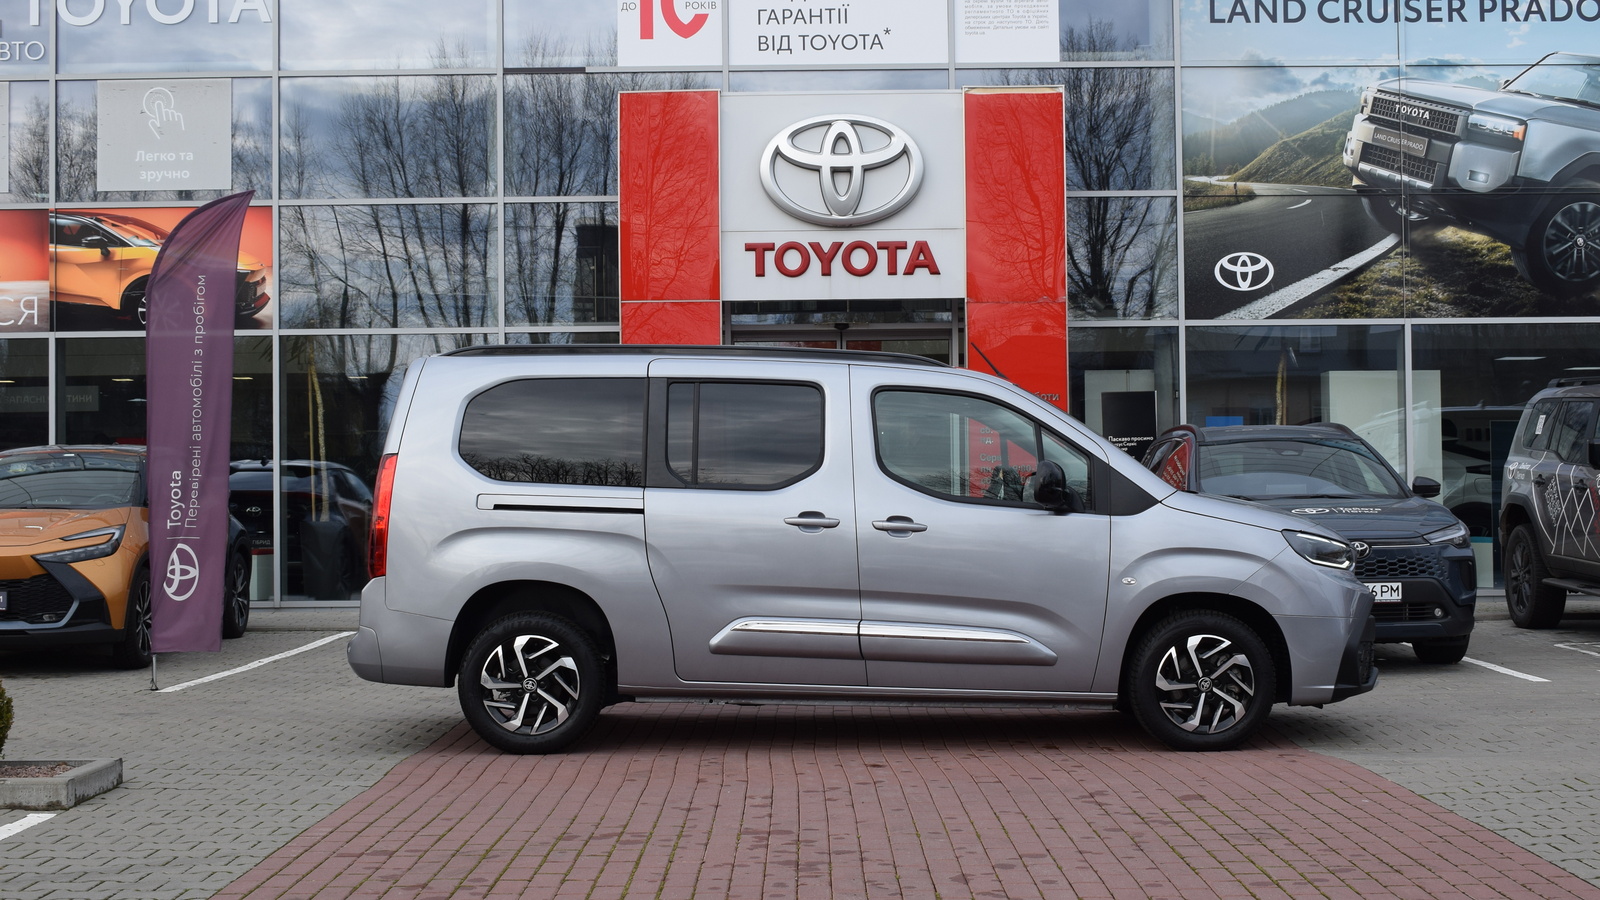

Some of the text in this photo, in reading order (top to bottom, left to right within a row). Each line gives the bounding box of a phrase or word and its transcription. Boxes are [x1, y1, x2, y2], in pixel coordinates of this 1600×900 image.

[620, 2, 637, 12] ДО
[685, 1, 717, 10] РОКІВ
[757, 4, 849, 26] ГАРАНТІЇ
[1209, 0, 1600, 24] LAND CRUISER PRADO
[758, 35, 793, 55] ВІД
[1395, 104, 1430, 120] TOYOTA
[1374, 132, 1424, 151] LAND CRUISER PRADO
[135, 150, 194, 163] Легко та
[139, 168, 190, 183] зручно
[744, 240, 941, 278] TOYOTA
[184, 274, 207, 528] Перевірені автомобілі з пробігом
[167, 470, 186, 530] Toyota
